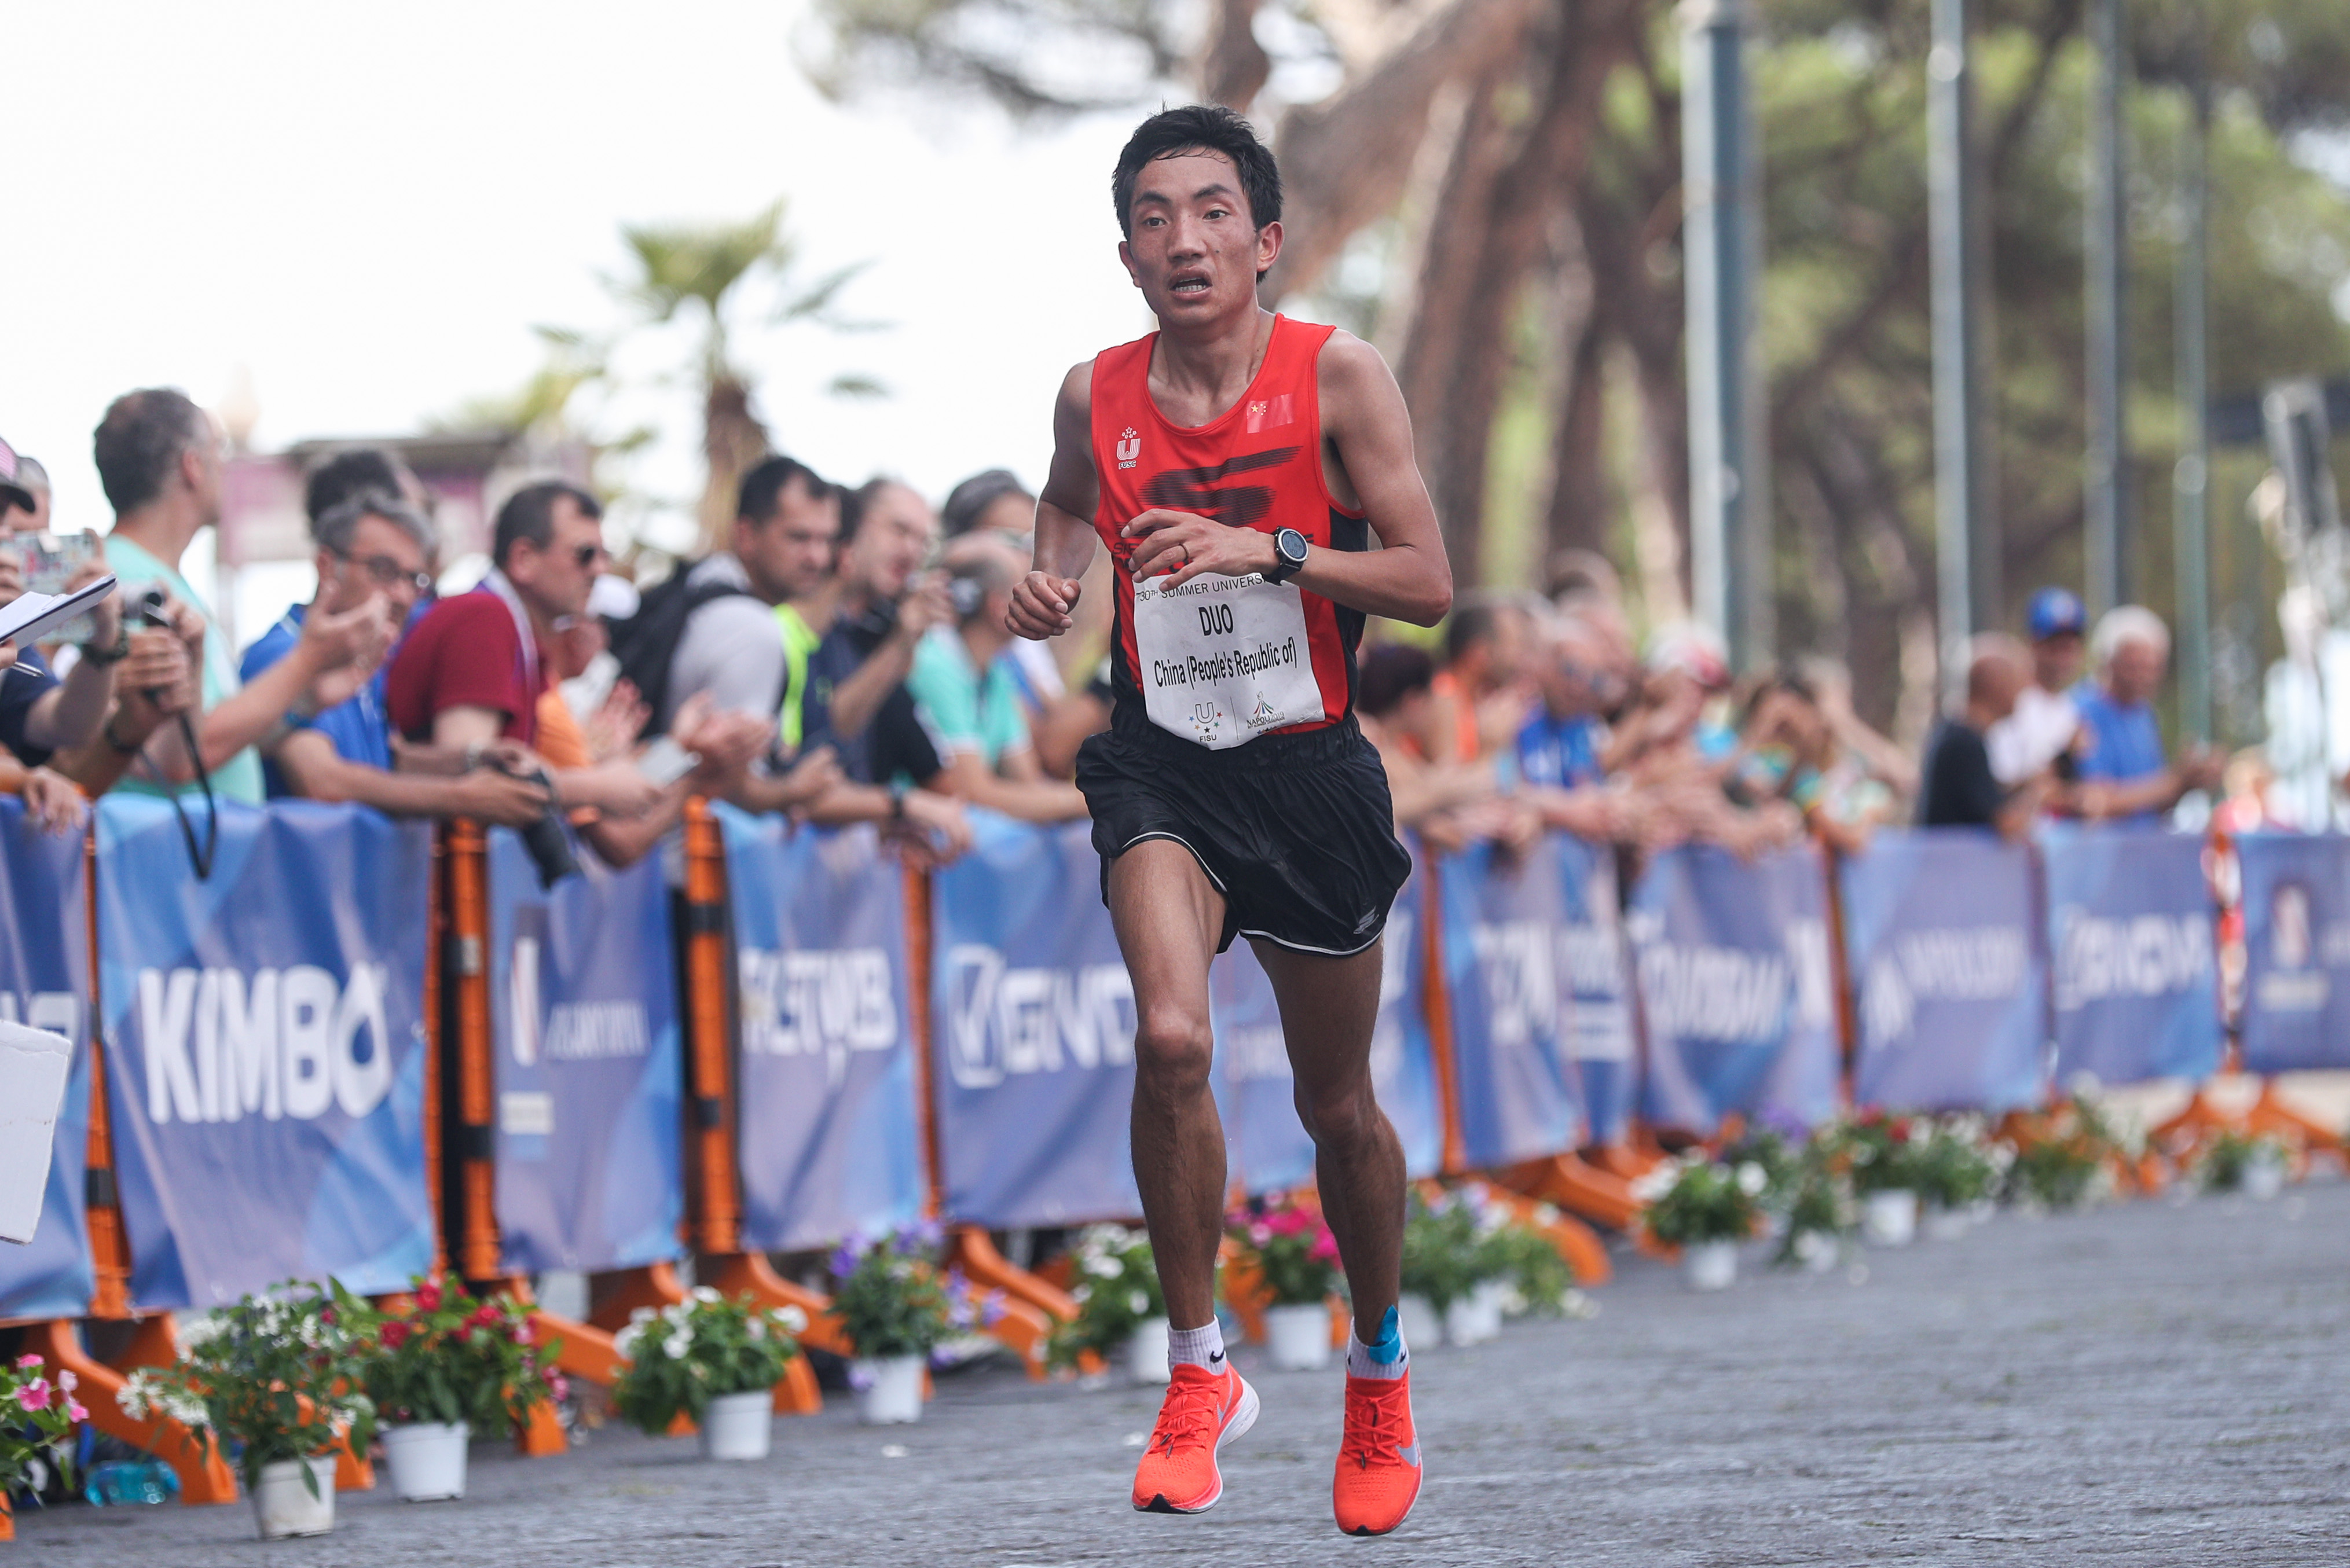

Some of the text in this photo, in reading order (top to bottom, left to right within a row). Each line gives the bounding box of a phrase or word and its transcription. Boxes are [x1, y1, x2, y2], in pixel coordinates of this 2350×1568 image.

[1161, 583, 1209, 598] SUMMER
[1212, 574, 1265, 592] UNIVERS
[1198, 603, 1233, 636] DUO
[1154, 636, 1297, 690] China (People's Republic of)
[1199, 734, 1218, 743] FISU
[139, 962, 393, 1124] KIMBO
